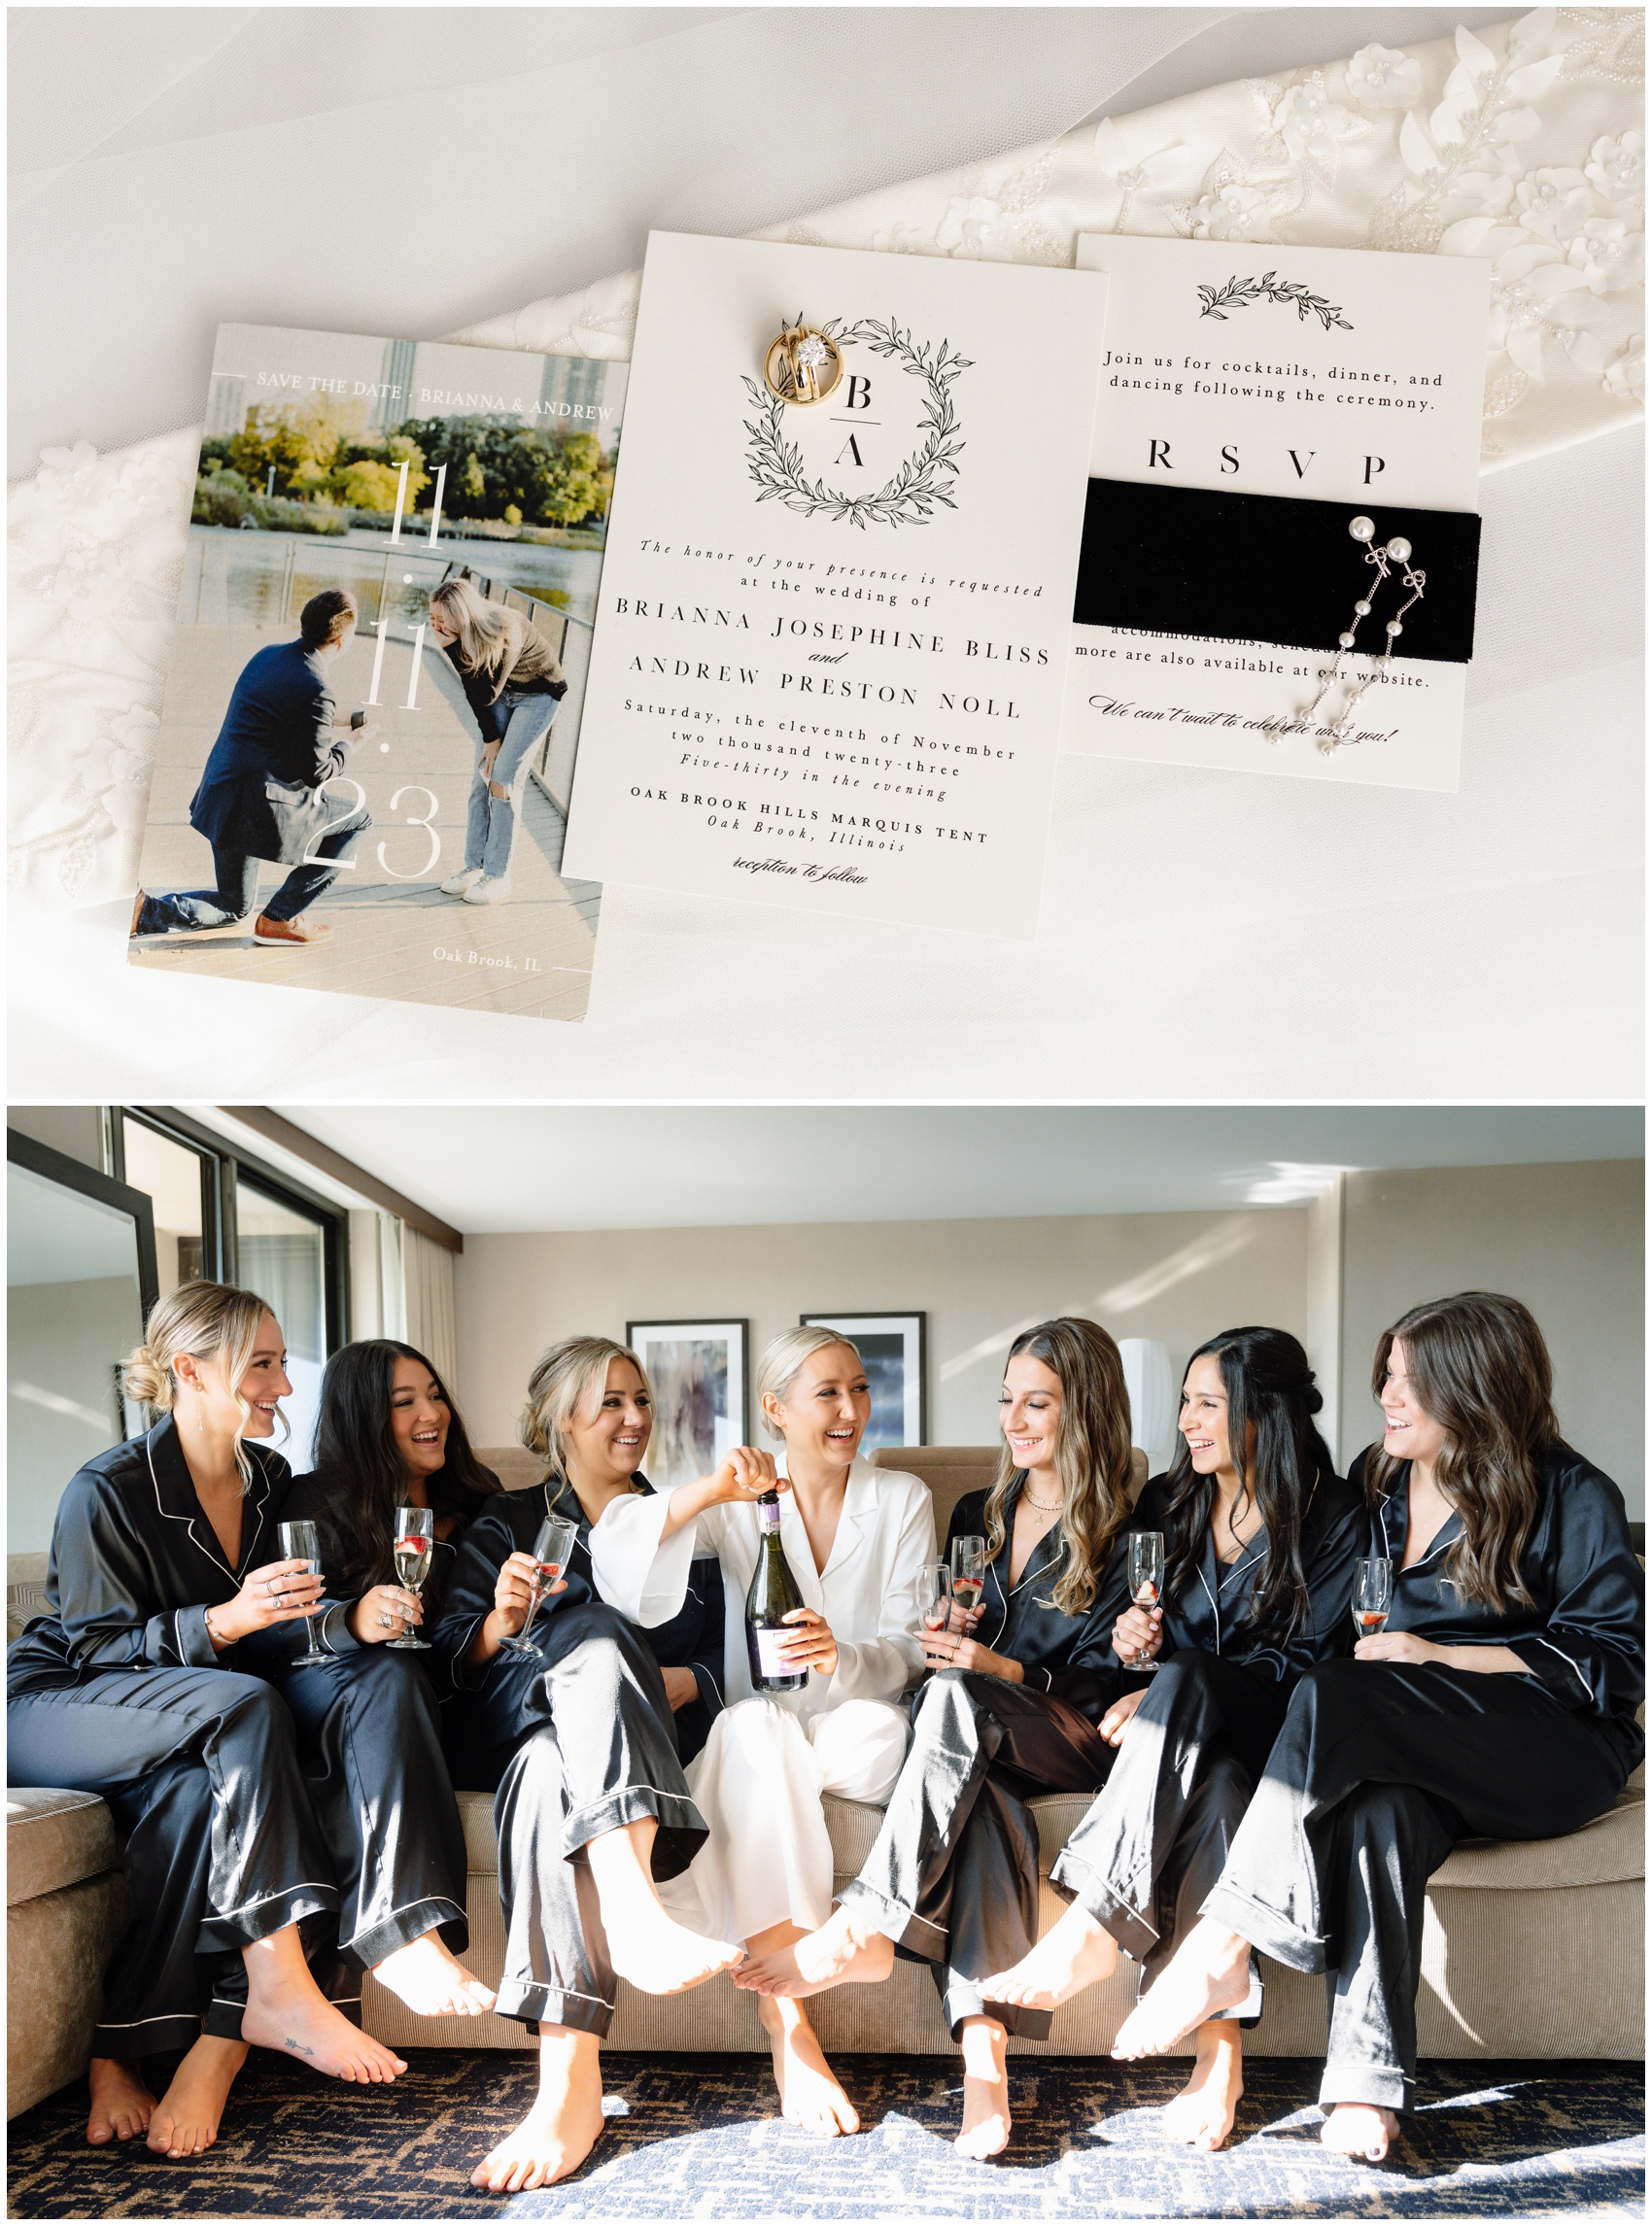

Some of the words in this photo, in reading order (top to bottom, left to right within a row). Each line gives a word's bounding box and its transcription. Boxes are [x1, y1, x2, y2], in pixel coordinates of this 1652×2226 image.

[1102, 350, 1144, 367] Join
[1153, 358, 1173, 368] us
[1184, 356, 1212, 370] for
[1222, 360, 1317, 380] cocktails,
[1327, 366, 1397, 386] dinner,
[1408, 373, 1442, 387] and
[257, 370, 302, 389] SAVE
[307, 376, 348, 394] THE
[353, 381, 402, 400] DATE
[420, 389, 506, 412] BRIANNA
[512, 396, 523, 412] &
[528, 400, 614, 421] ANDREW
[843, 374, 872, 410] B
[1109, 374, 1184, 395] dancing
[1193, 380, 1287, 403] following
[1296, 388, 1325, 402] the
[1336, 394, 1434, 413] ceremony.
[833, 432, 865, 467] A
[640, 539, 671, 554] The
[683, 544, 735, 562] honor
[746, 553, 767, 567] of
[773, 559, 815, 570] your
[825, 563, 908, 582] presence
[920, 572, 936, 585] is
[948, 579, 1043, 598] requested
[740, 577, 758, 587] at
[772, 578, 801, 593] the
[814, 586, 898, 607] wedding
[911, 596, 931, 607] of
[614, 597, 750, 630] BRIANNA
[770, 616, 944, 653] JOSEPHINE
[964, 639, 1049, 666] BLISS
[808, 651, 850, 665] and
[1074, 646, 1117, 659] more
[1125, 651, 1152, 662] are
[1160, 651, 1195, 667] also
[1203, 657, 1284, 674] available
[1292, 666, 1309, 677] at
[1357, 670, 1429, 688] website.
[629, 655, 760, 686] ANDREW
[779, 672, 918, 705] PRESTON
[938, 693, 1020, 719] NOLL
[624, 699, 721, 725] Saturday,
[735, 714, 765, 728] the
[778, 720, 866, 741] eleventh
[880, 733, 901, 745] of
[912, 735, 1015, 760] November
[1088, 695, 1136, 717] We
[1180, 711, 1230, 726] wait
[1217, 711, 1244, 728] to
[1355, 729, 1399, 743] you!
[671, 731, 705, 743] two
[718, 736, 811, 758] thousand
[824, 750, 959, 777] twenty-three
[679, 753, 789, 781] Five-thirty
[802, 769, 819, 782] in
[832, 773, 860, 788] the
[873, 782, 947, 803] evening
[303, 777, 442, 878] 23
[630, 786, 669, 801] OAK
[679, 792, 747, 811] BROOK
[759, 803, 818, 821] HILLS
[830, 812, 922, 835] MARQUIS
[935, 827, 987, 843] TENT
[707, 814, 740, 830] Oak
[752, 820, 814, 842] Brook,
[828, 831, 905, 852] Illinois
[733, 856, 799, 875] reception
[801, 863, 824, 878] to
[809, 865, 869, 885] follow
[432, 946, 463, 963] Oak
[467, 950, 517, 970] Brook,
[524, 957, 541, 972] IL
